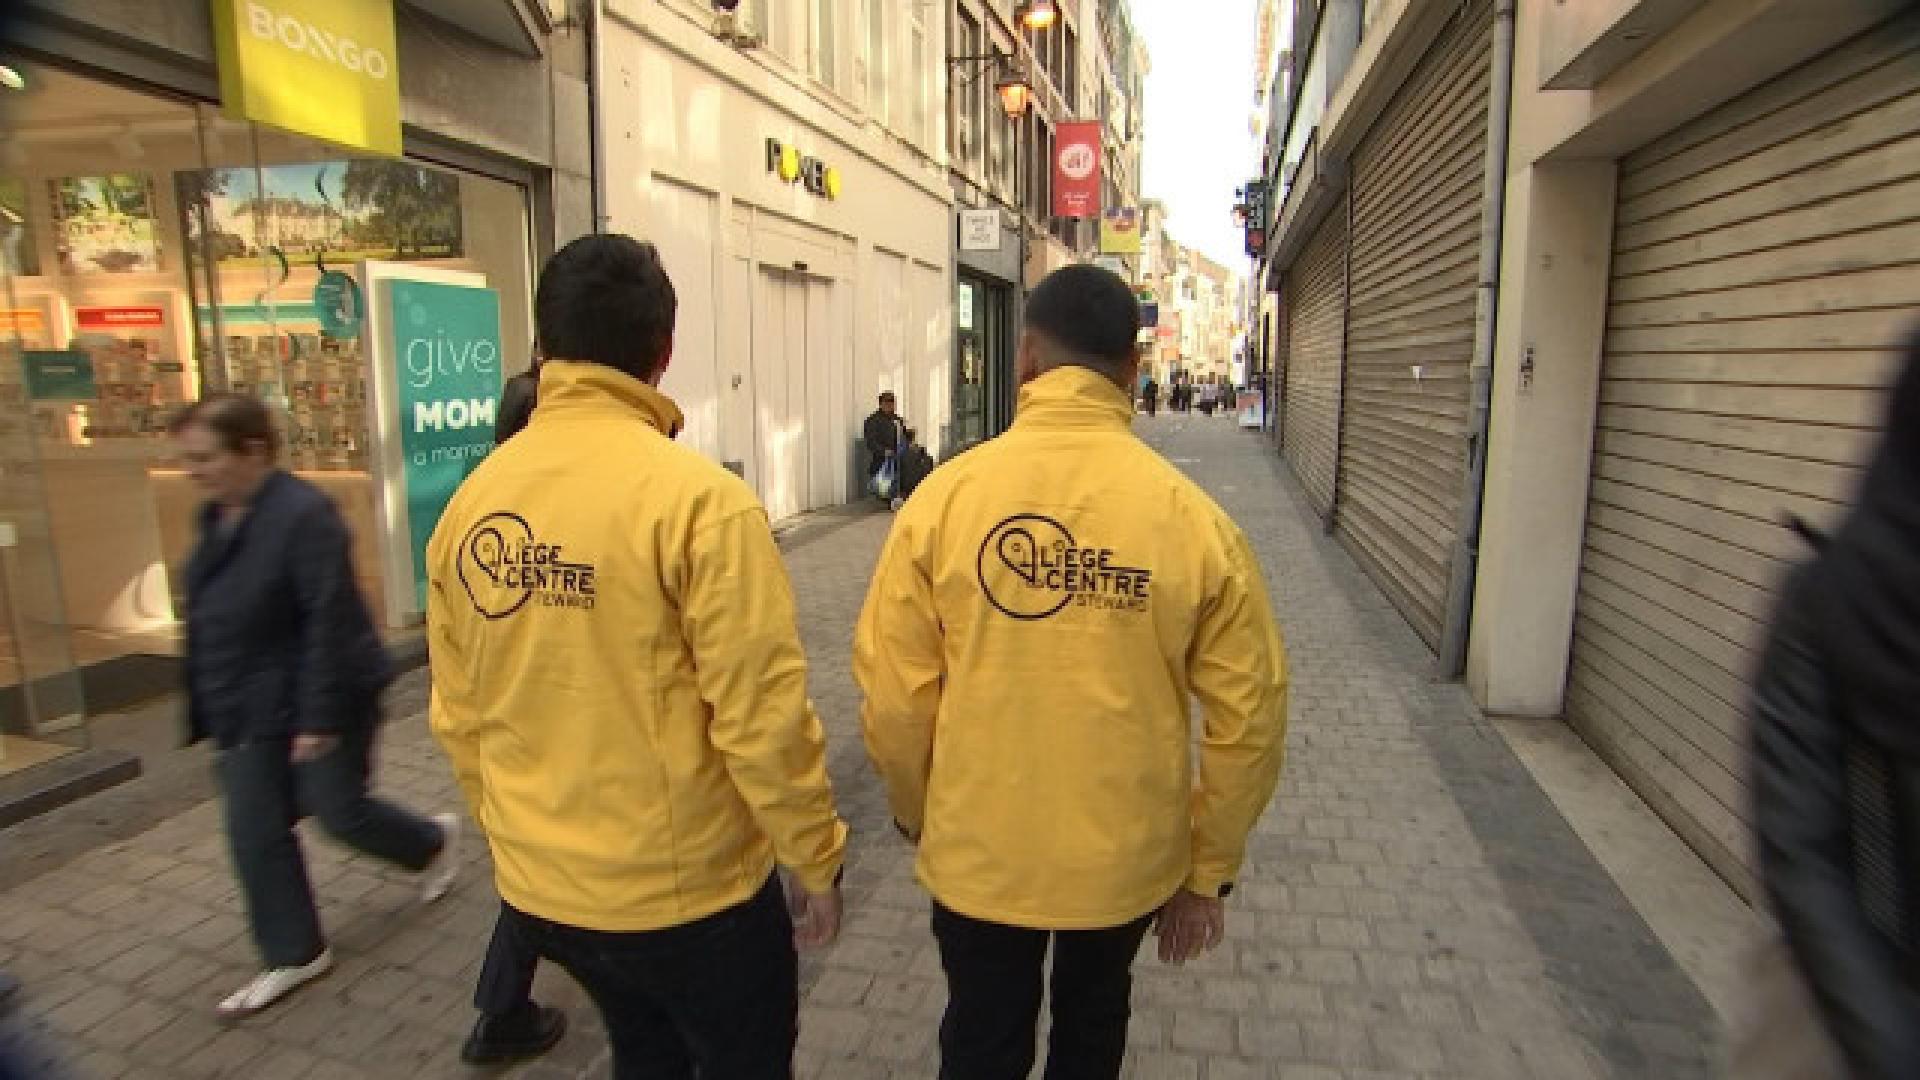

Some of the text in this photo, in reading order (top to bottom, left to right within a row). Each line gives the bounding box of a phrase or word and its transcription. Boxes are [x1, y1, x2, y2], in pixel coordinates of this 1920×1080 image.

[248, 2, 387, 79] BONGO
[408, 329, 496, 388] give
[413, 396, 496, 432] MOM
[414, 452, 427, 466] a
[505, 566, 595, 594] CENTRE
[1047, 569, 1151, 597] CENTRE
